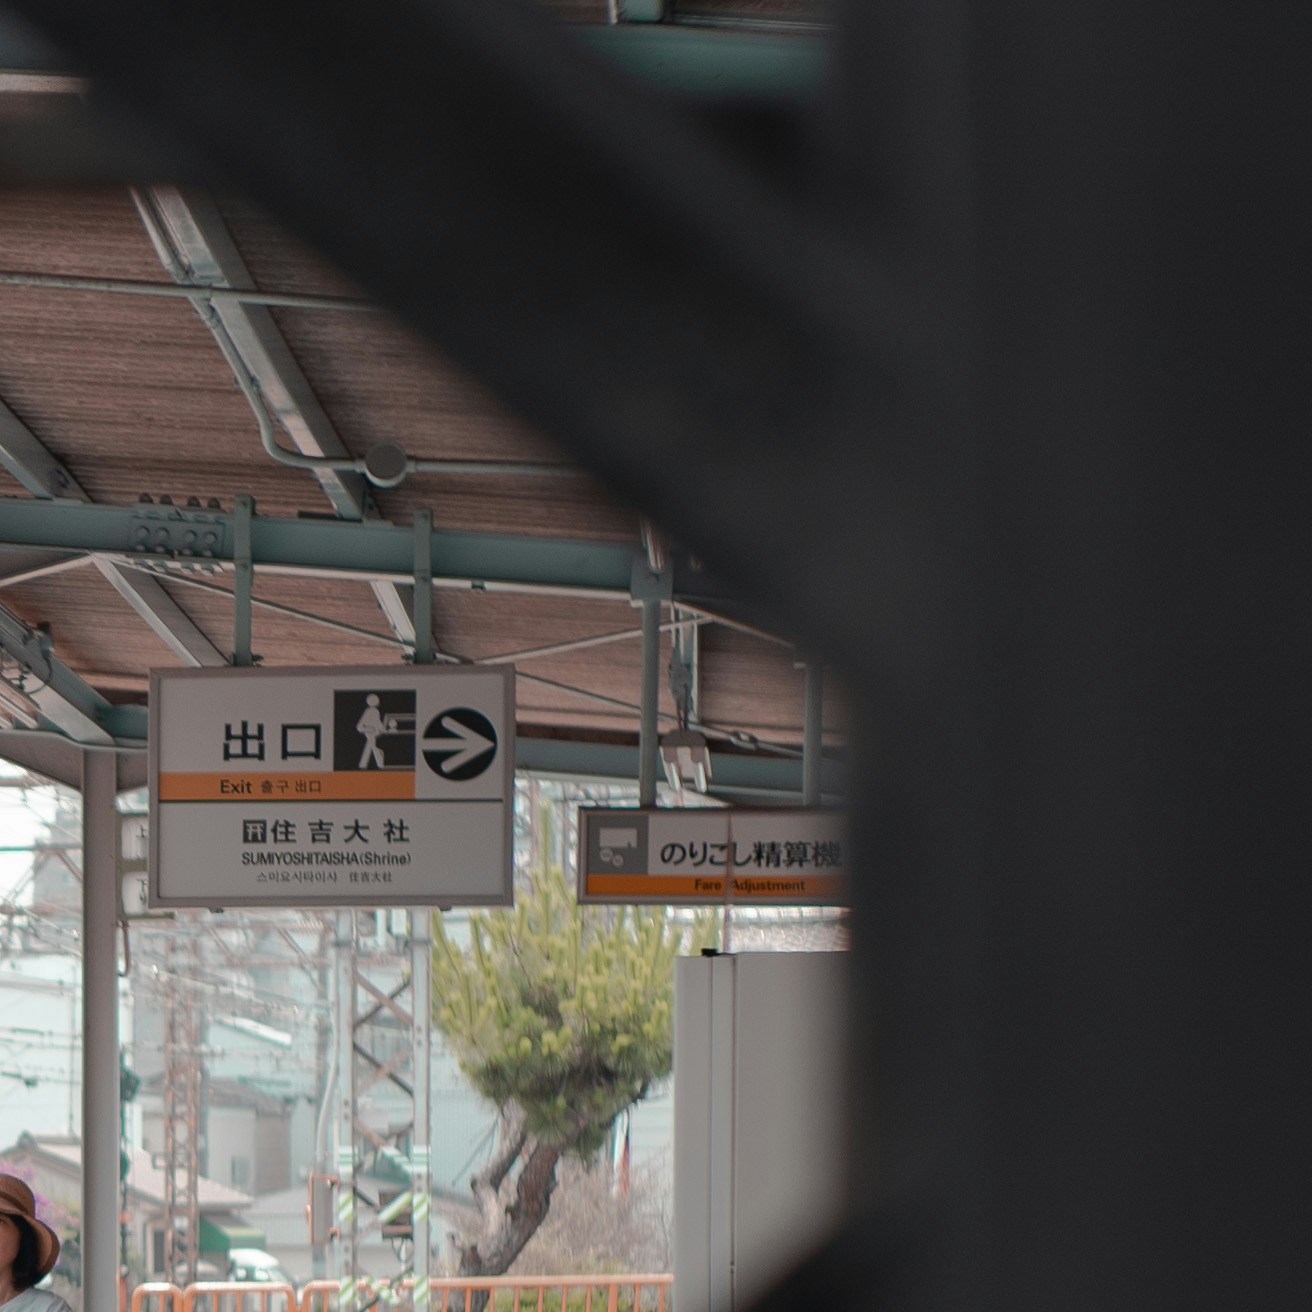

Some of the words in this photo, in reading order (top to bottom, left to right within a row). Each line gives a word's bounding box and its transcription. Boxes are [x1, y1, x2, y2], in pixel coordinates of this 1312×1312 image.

[222, 719, 323, 762] 出口
[220, 779, 253, 794] Exit
[295, 779, 322, 793] 出口
[270, 818, 411, 844] 住吉大社
[660, 839, 842, 868] のりこし精算機
[694, 878, 722, 891] Fare
[731, 878, 806, 893] Adjustment
